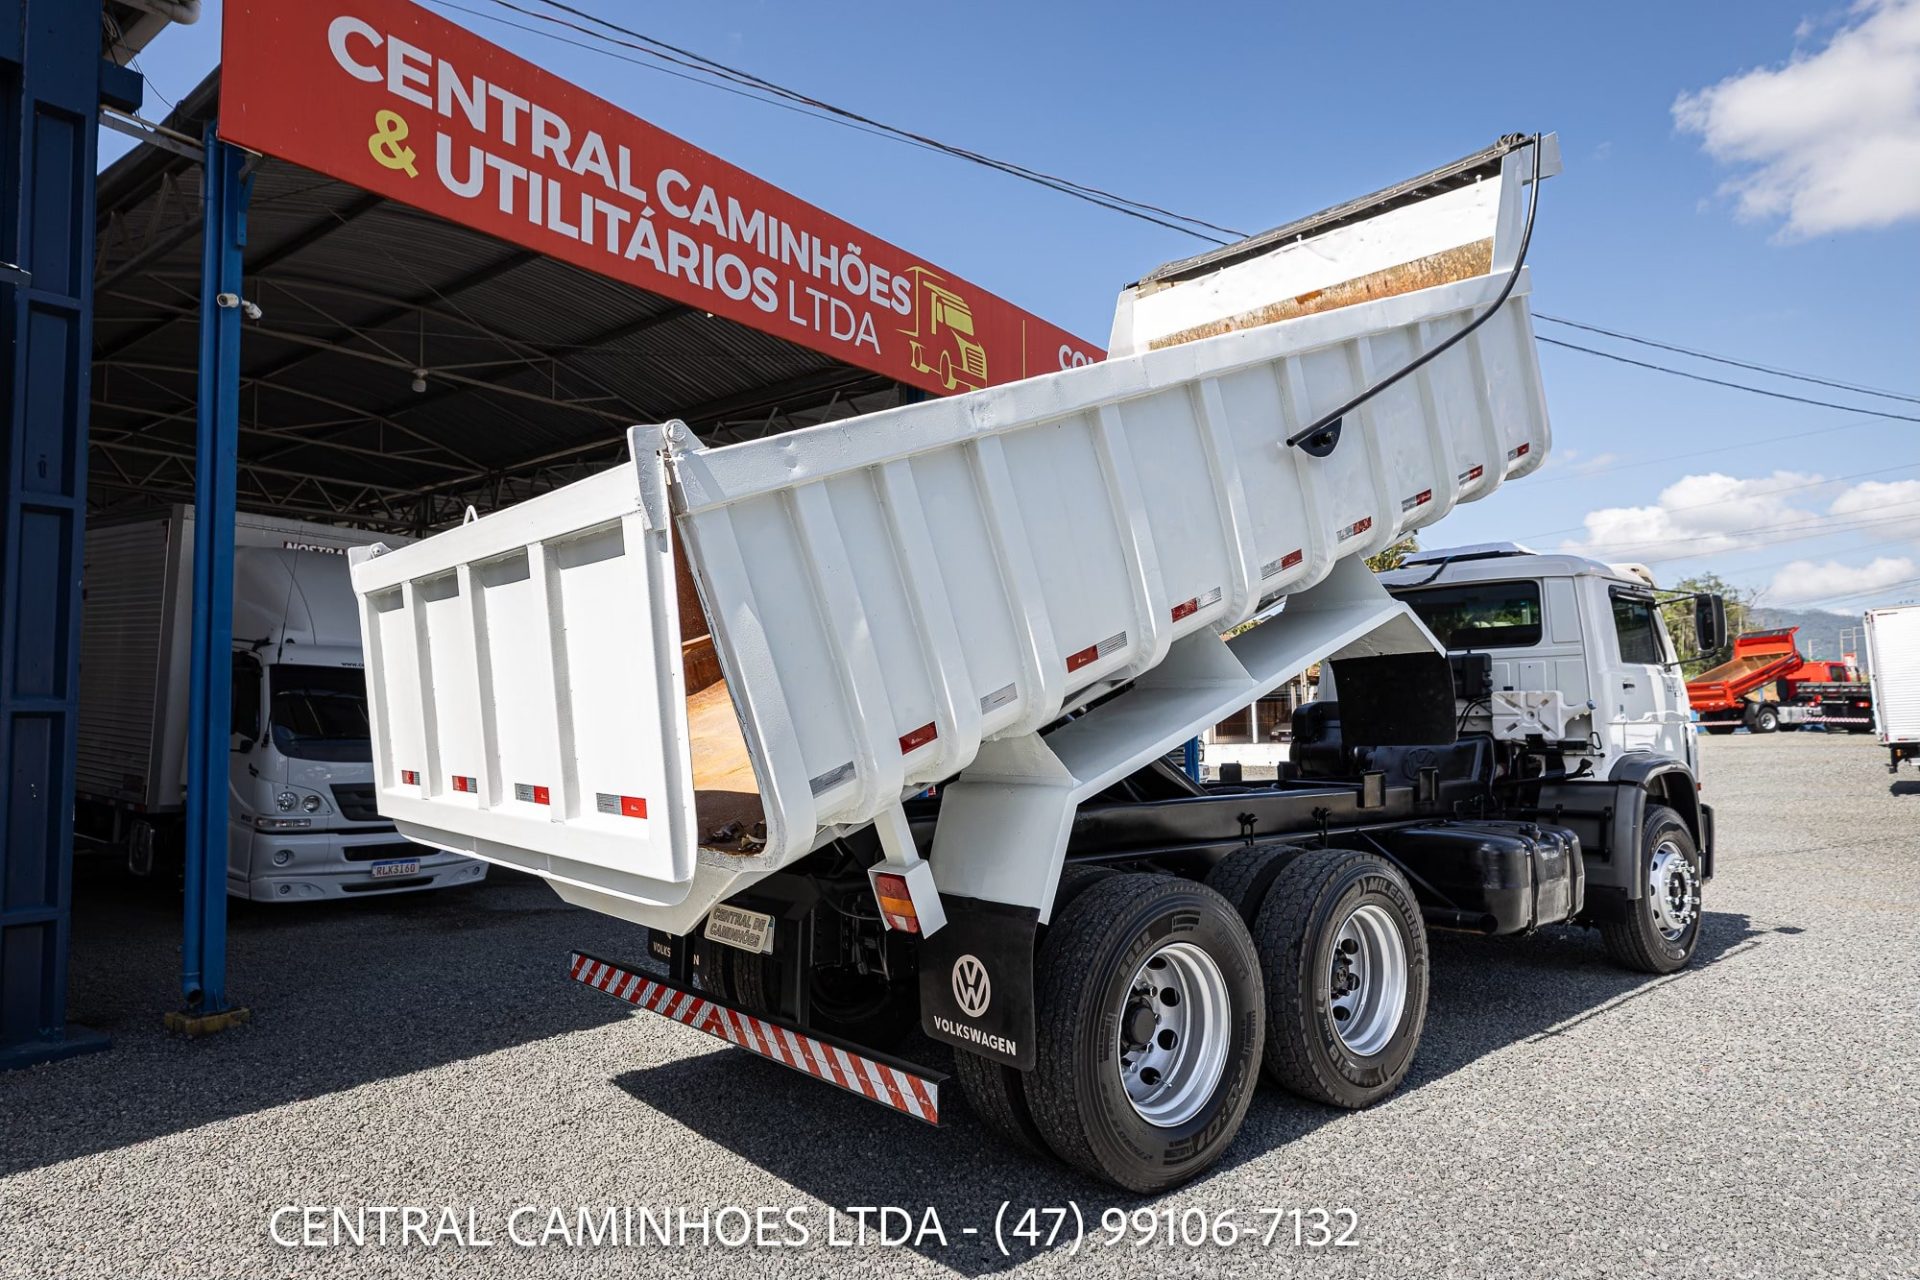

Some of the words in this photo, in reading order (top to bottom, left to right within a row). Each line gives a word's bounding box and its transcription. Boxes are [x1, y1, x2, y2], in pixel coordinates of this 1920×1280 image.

[328, 16, 647, 203] CENTRAL
[656, 168, 912, 315] CAMINHÕES
[368, 109, 419, 179] &
[436, 131, 778, 313] UTILITÁRIOS
[789, 279, 881, 355] LTDA
[711, 907, 752, 928] CENTRAL
[752, 917, 767, 932] DE
[934, 1015, 1017, 1056] VOLKSWAGEN
